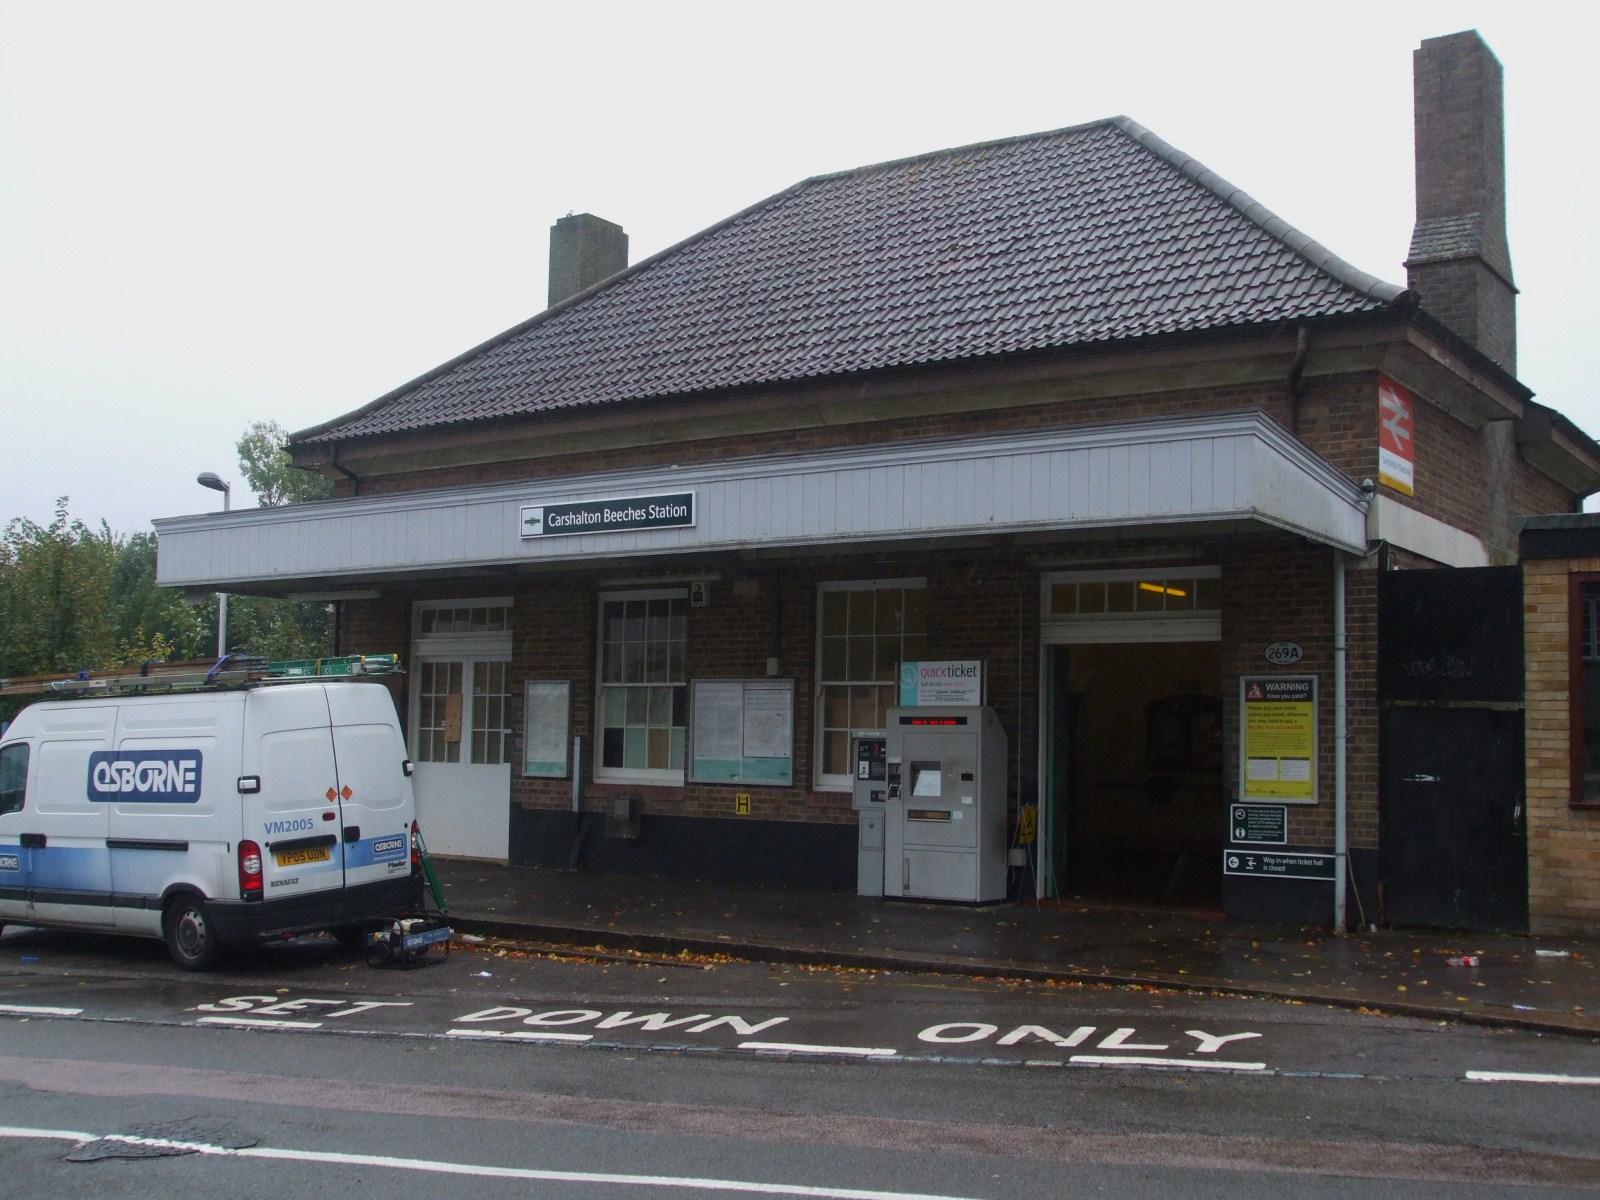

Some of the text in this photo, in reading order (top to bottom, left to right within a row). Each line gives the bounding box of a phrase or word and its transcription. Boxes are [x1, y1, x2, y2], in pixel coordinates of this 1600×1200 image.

[548, 503, 687, 527] Carshalton Beeches Station
[1268, 647, 1299, 659] 269A
[921, 664, 977, 678] quickticket
[1265, 682, 1309, 691] WARNING
[93, 760, 196, 792] OSBORNE
[738, 796, 748, 812] H
[264, 818, 314, 834] VM2005
[375, 840, 403, 851] OSBORNE
[1263, 857, 1275, 865] Way
[197, 996, 1263, 1053] SET DOWN ONLY
